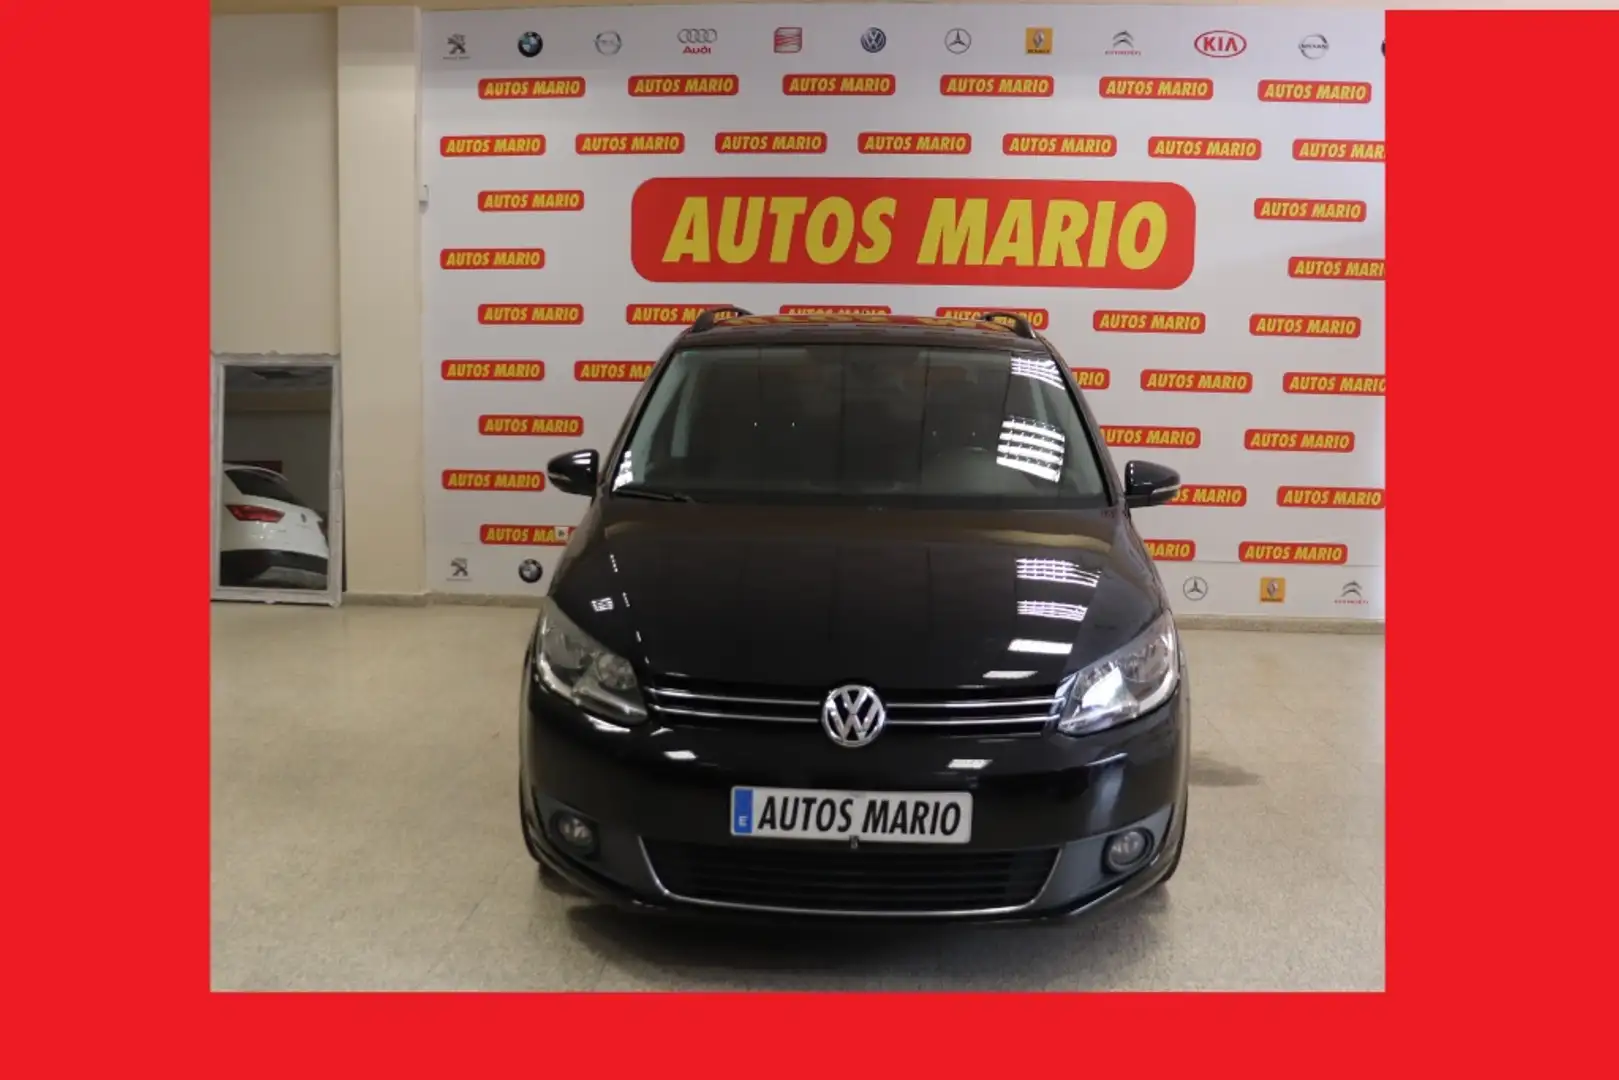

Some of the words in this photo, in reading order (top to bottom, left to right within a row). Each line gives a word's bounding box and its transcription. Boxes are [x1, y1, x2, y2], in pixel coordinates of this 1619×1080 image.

[485, 82, 529, 96] AUTOS
[531, 81, 580, 96] MARIO
[634, 79, 681, 93] AUTOS
[685, 78, 733, 92] MARIO
[789, 78, 837, 92] AUTOS
[841, 77, 890, 91] MARIO
[946, 78, 994, 92] AUTOS
[998, 78, 1049, 93] MARIO
[1106, 80, 1154, 94] AUTOS
[1157, 81, 1209, 96] MARIO
[1265, 84, 1313, 98] AUTOS
[1316, 85, 1368, 99] MARIO
[445, 138, 490, 154] AUTOS
[493, 138, 542, 153] MARIO
[582, 136, 628, 151] AUTOS
[630, 136, 680, 152] MARIO
[721, 135, 768, 150] AUTOS
[771, 135, 822, 150] MARIO
[864, 135, 912, 150] AUTOS
[915, 136, 967, 151] MARIO
[1009, 137, 1058, 152] AUTOS
[1061, 138, 1113, 153] MARIO
[1154, 140, 1203, 155] AUTOS
[1206, 141, 1257, 157] MARIO
[1299, 142, 1347, 157] AUTOS
[1350, 143, 1385, 158] MAR
[483, 193, 529, 208] AUTOS
[531, 192, 581, 208] MARIO
[1260, 202, 1308, 217] AUTOS
[1313, 203, 1362, 218] MARIO
[662, 196, 897, 264] AUTOS
[917, 198, 1168, 270] MARIO
[446, 252, 490, 267] AUTOS
[494, 252, 541, 267] MARIO
[1294, 260, 1342, 276] AUTOS
[1343, 262, 1385, 277] MARI
[483, 307, 529, 322] AUTOS
[532, 307, 580, 322] MARIO
[632, 307, 678, 322] AUTOS
[1099, 313, 1147, 328] AUTOS
[1150, 315, 1201, 331] MARIO
[1255, 318, 1303, 333] AUTOS
[1306, 319, 1357, 335] MARIO
[447, 363, 490, 378] AUTOS
[493, 363, 541, 378] MARIO
[580, 364, 626, 379] AUTOS
[1072, 371, 1105, 386] RIO
[1146, 373, 1194, 388] AUTOS
[1196, 374, 1248, 389] MARIO
[1289, 376, 1336, 391] AUTOS
[484, 418, 529, 433] AUTOS
[531, 419, 579, 434] MARIO
[1101, 428, 1142, 444] UTOS
[1145, 430, 1196, 445] MARIO
[1250, 433, 1298, 448] AUTOS
[1301, 434, 1350, 449] MARIO
[448, 473, 491, 488] AUTOS
[493, 474, 541, 489] MARIO
[1192, 487, 1243, 503] MARIO
[1283, 489, 1330, 505] AUTOS
[1333, 491, 1382, 506] MARIO
[485, 527, 530, 542] AUTOS
[1245, 545, 1292, 560] AUTOS
[1294, 546, 1343, 562] MARIO
[738, 816, 748, 827] E
[757, 795, 854, 832] AUTOS
[861, 799, 961, 836] MARIO
